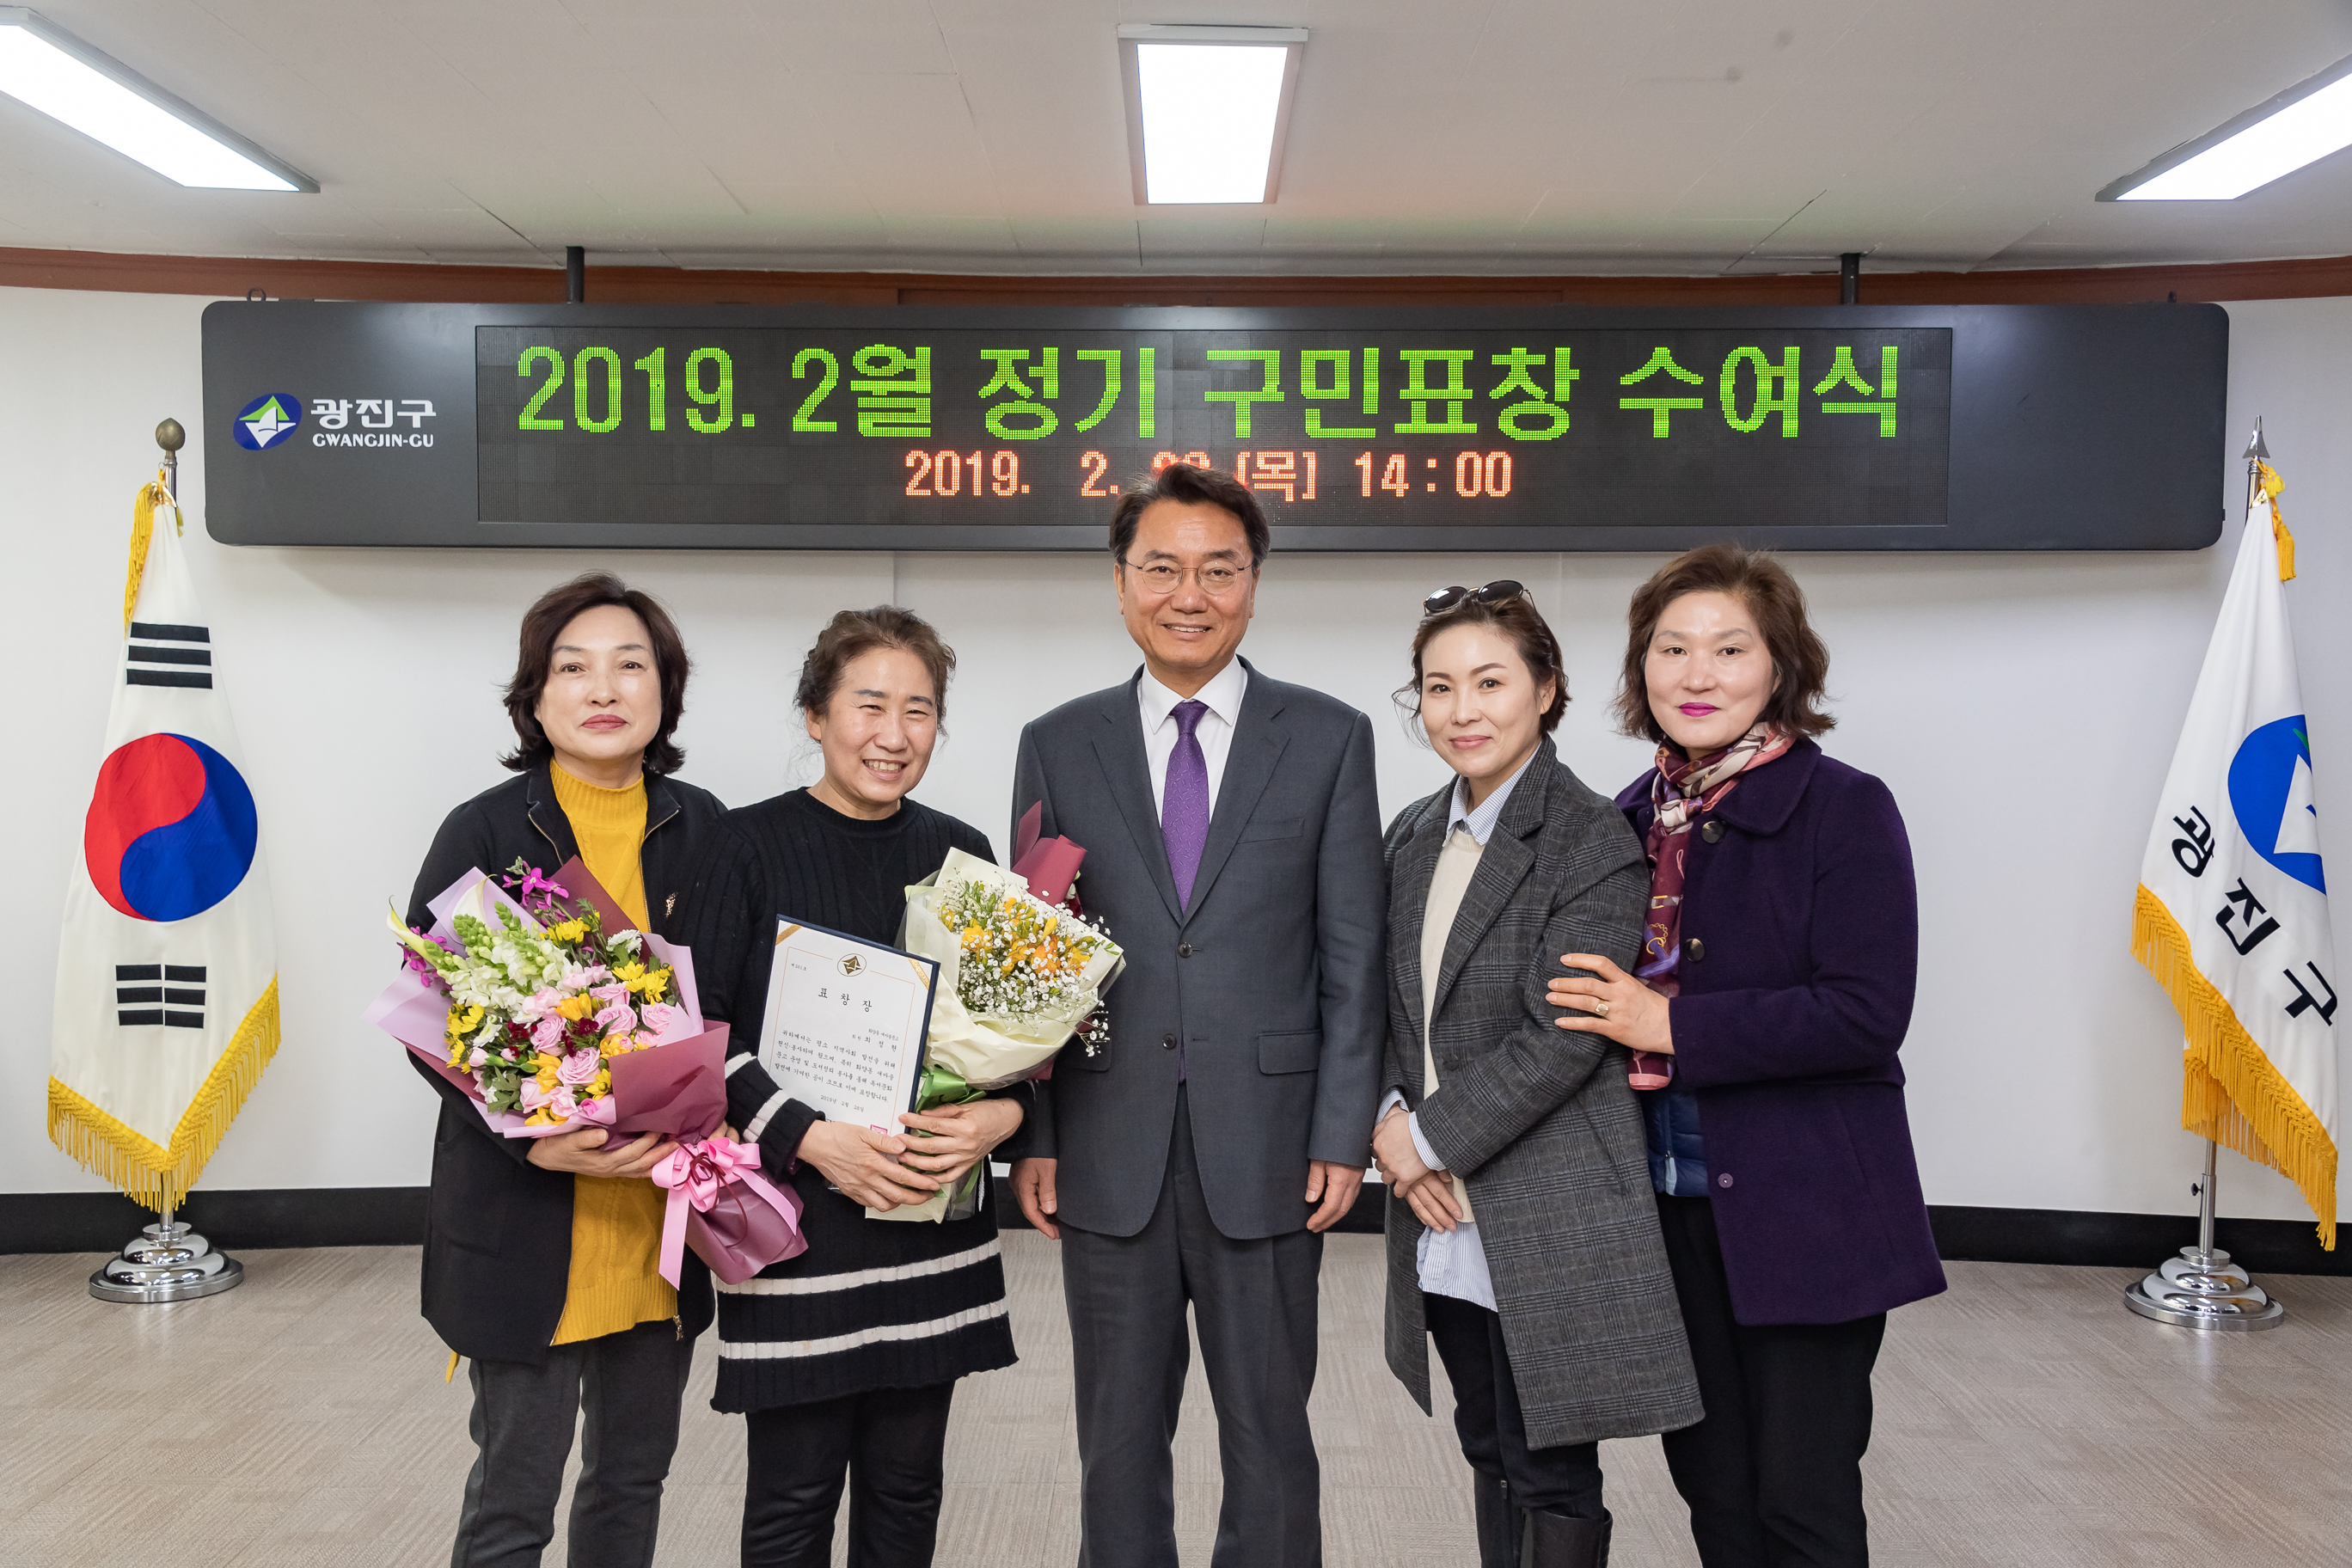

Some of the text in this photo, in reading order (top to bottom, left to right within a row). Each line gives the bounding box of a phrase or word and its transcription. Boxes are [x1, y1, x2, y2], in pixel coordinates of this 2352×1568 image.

[518, 344, 1899, 441] 2019. 2월 정기 구민표창 수여식
[310, 399, 437, 430] 광진구
[312, 432, 435, 448] GWANGJIN-GU
[905, 450, 1030, 497] 2019.
[2171, 805, 2338, 1026] 광진구
[782, 1030, 812, 1044] 귀하께서는
[817, 1040, 828, 1049] 평소
[834, 1045, 856, 1057] 지역사회
[861, 1054, 879, 1064] 발전을
[775, 1063, 791, 1072] 발전에
[793, 1069, 810, 1079] 기여한
[826, 1079, 842, 1088] 크므로
[776, 1051, 787, 1060] 문고
[790, 1056, 801, 1064] 운영
[812, 1063, 834, 1074] 도서정리
[837, 1070, 853, 1081] 봉사를
[870, 1080, 892, 1092] 독서문화
[855, 1064, 873, 1075] 화양동
[877, 1071, 894, 1081] 새마을
[820, 1094, 837, 1104] 2019년
